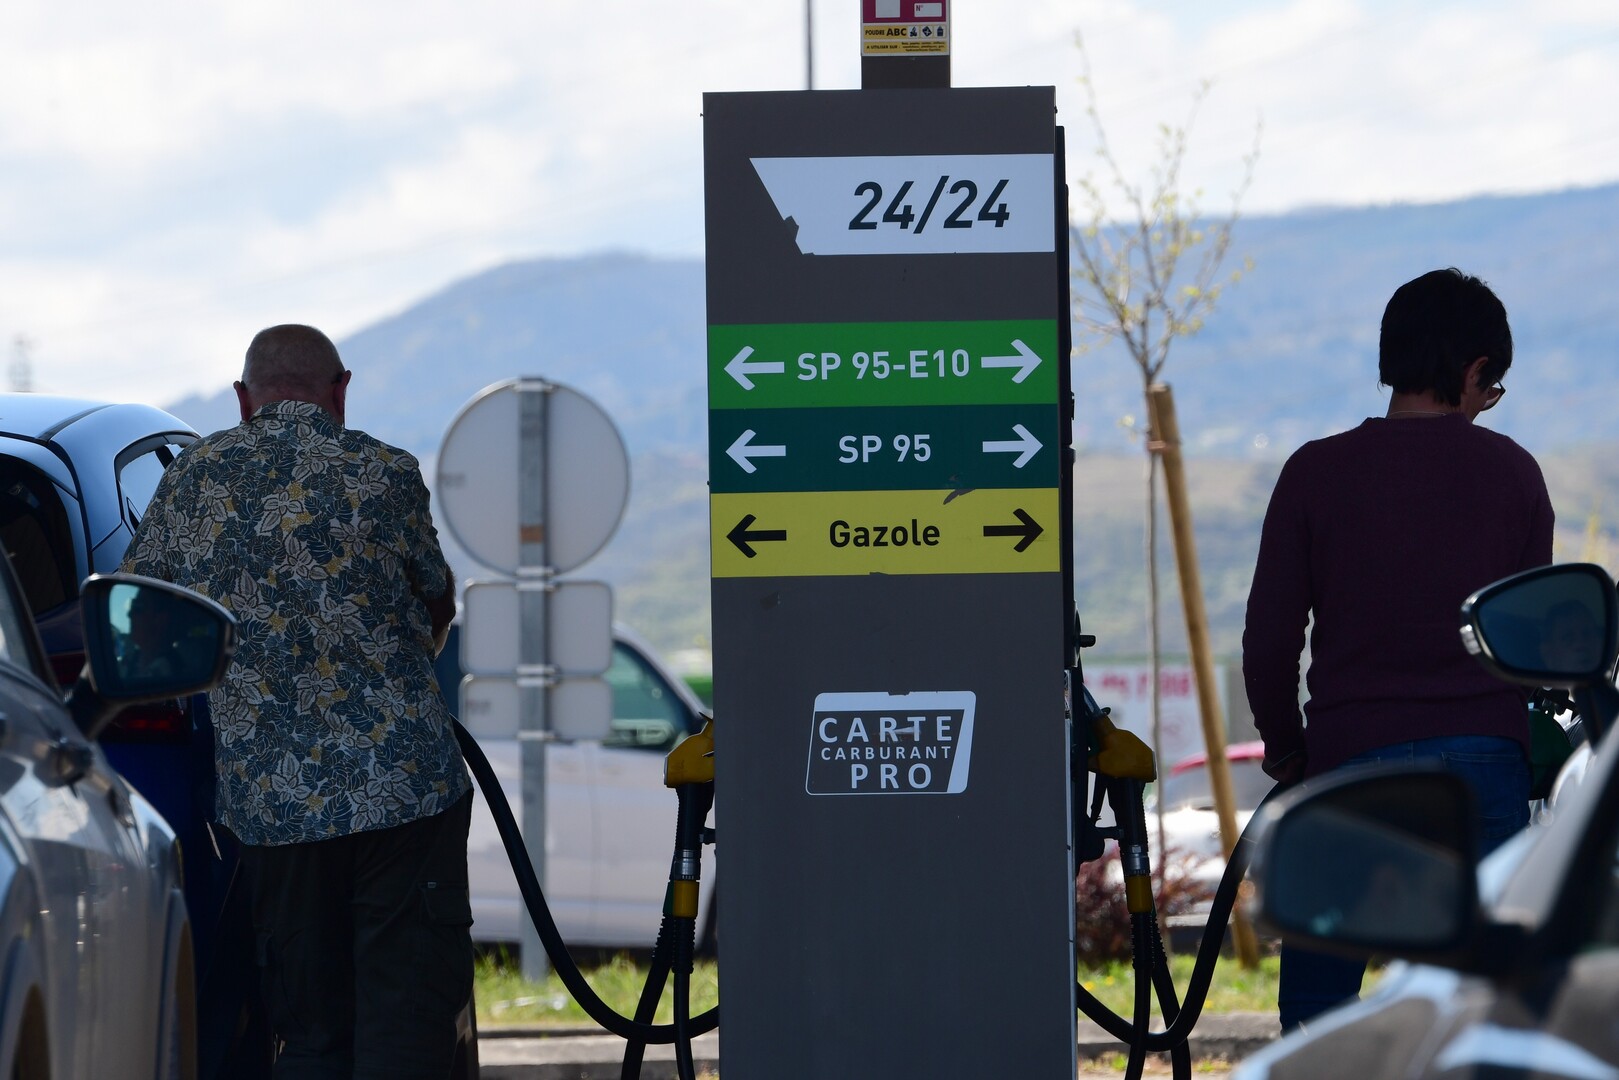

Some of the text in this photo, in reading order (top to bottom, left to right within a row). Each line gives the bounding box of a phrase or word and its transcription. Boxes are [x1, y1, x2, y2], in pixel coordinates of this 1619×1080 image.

[886, 28, 907, 36] ABC
[848, 175, 1011, 234] 24/24
[797, 349, 970, 381] SP 95-E10
[839, 434, 932, 464] SP 95
[829, 518, 941, 548] Gazole
[818, 716, 952, 743] CARTE
[821, 746, 951, 760] CARBURANT
[851, 763, 932, 789] PRO
